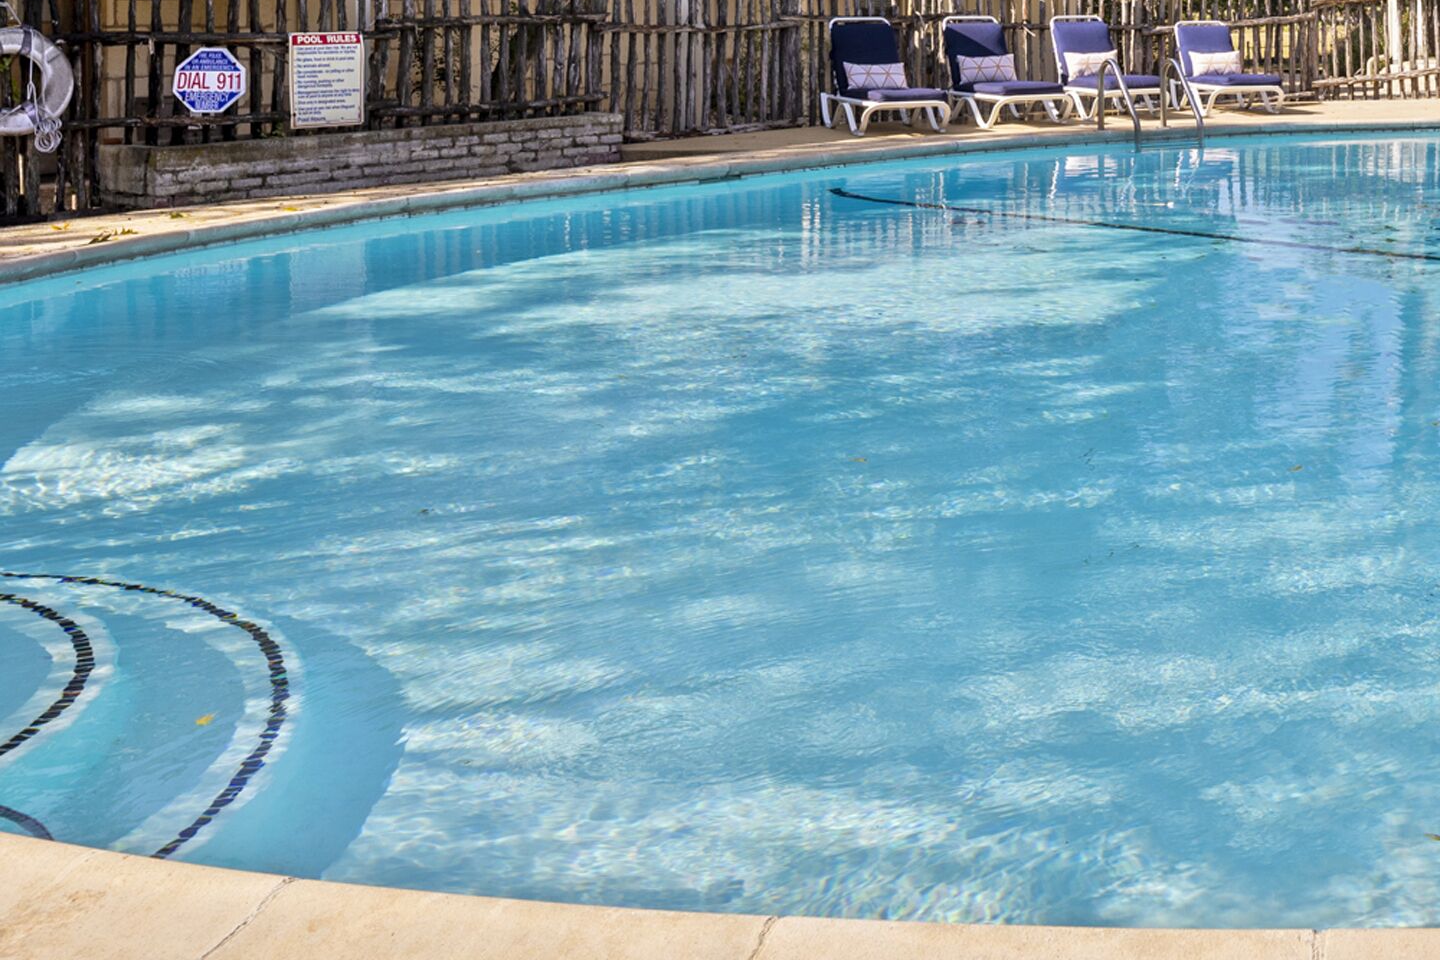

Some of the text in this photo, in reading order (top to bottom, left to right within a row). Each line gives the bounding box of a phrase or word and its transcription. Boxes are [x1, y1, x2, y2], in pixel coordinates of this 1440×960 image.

[297, 34, 357, 44] POOL RULES
[177, 72, 242, 90] DIAL 911
